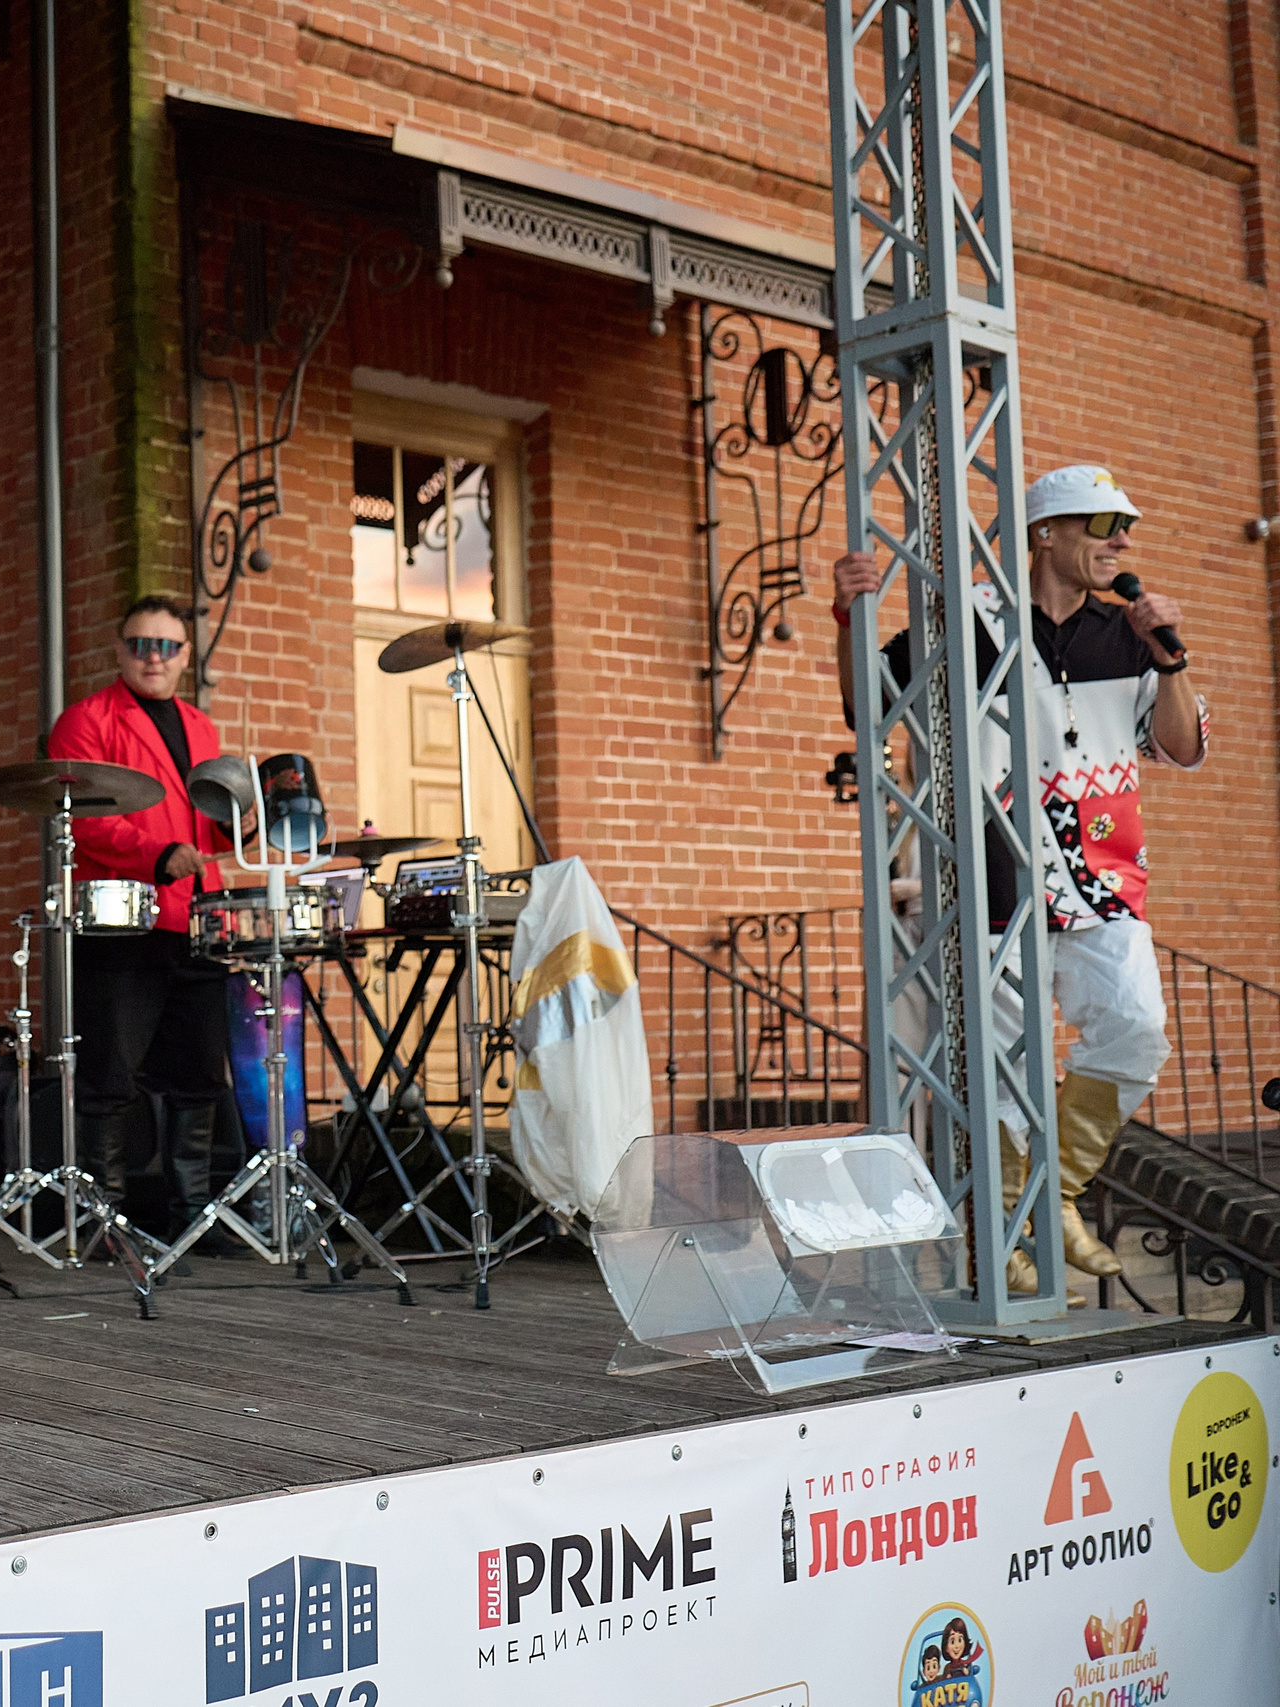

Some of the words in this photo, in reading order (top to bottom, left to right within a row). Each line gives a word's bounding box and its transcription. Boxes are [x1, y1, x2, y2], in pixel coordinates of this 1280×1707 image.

[1206, 1407, 1251, 1438] ВОРОНЕЖ
[805, 1447, 976, 1500] ТИПОГРАФИЯ
[1187, 1451, 1239, 1499] Like
[1240, 1459, 1252, 1489] &
[1207, 1491, 1241, 1530] Go
[808, 1494, 978, 1578] Лондон
[487, 1557, 501, 1620] PULSE
[505, 1507, 716, 1626] PRIME
[1007, 1545, 1054, 1586] АРТ
[478, 1595, 716, 1669] МЕДИАПРОЕКТ
[1074, 1660, 1106, 1689] Мой
[1109, 1662, 1119, 1681] и
[1122, 1645, 1158, 1677] твой
[921, 1681, 969, 1707] КАТЯ
